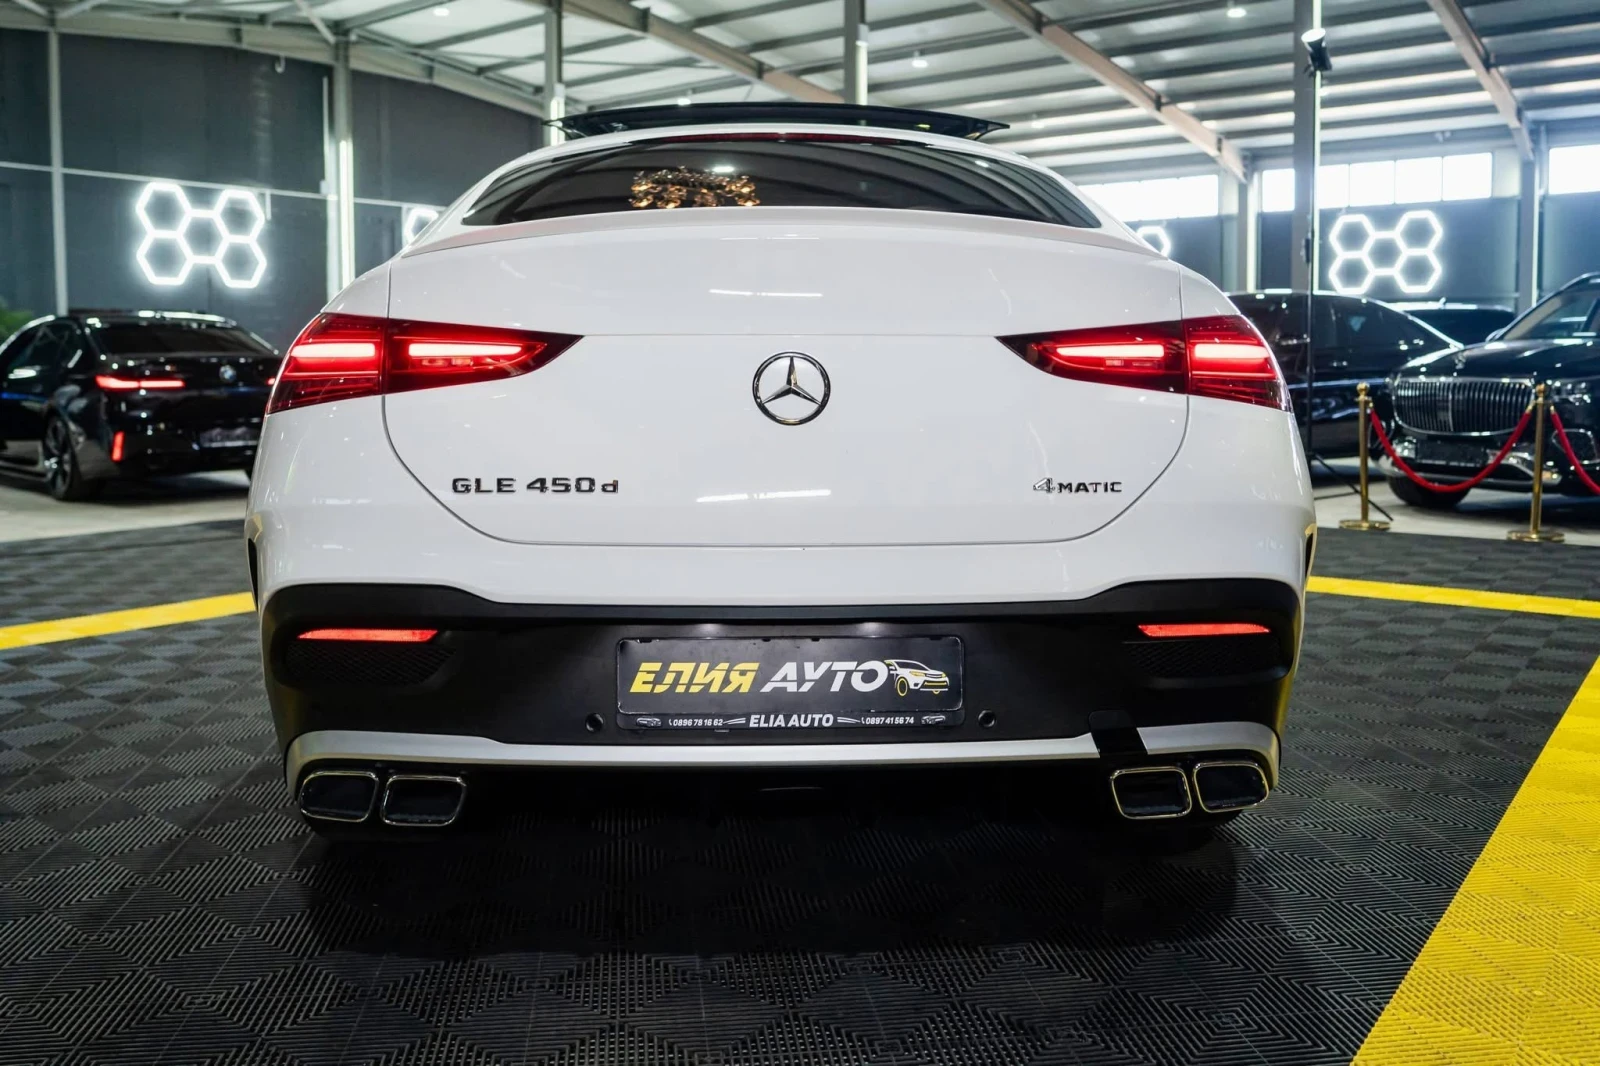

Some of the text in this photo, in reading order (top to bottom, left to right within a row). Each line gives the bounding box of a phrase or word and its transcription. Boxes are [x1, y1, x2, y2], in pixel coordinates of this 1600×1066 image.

[452, 477, 516, 494] GLE
[629, 660, 889, 693] ЕЛИЯ АУТО
[749, 713, 834, 728] ELIA AUTO
